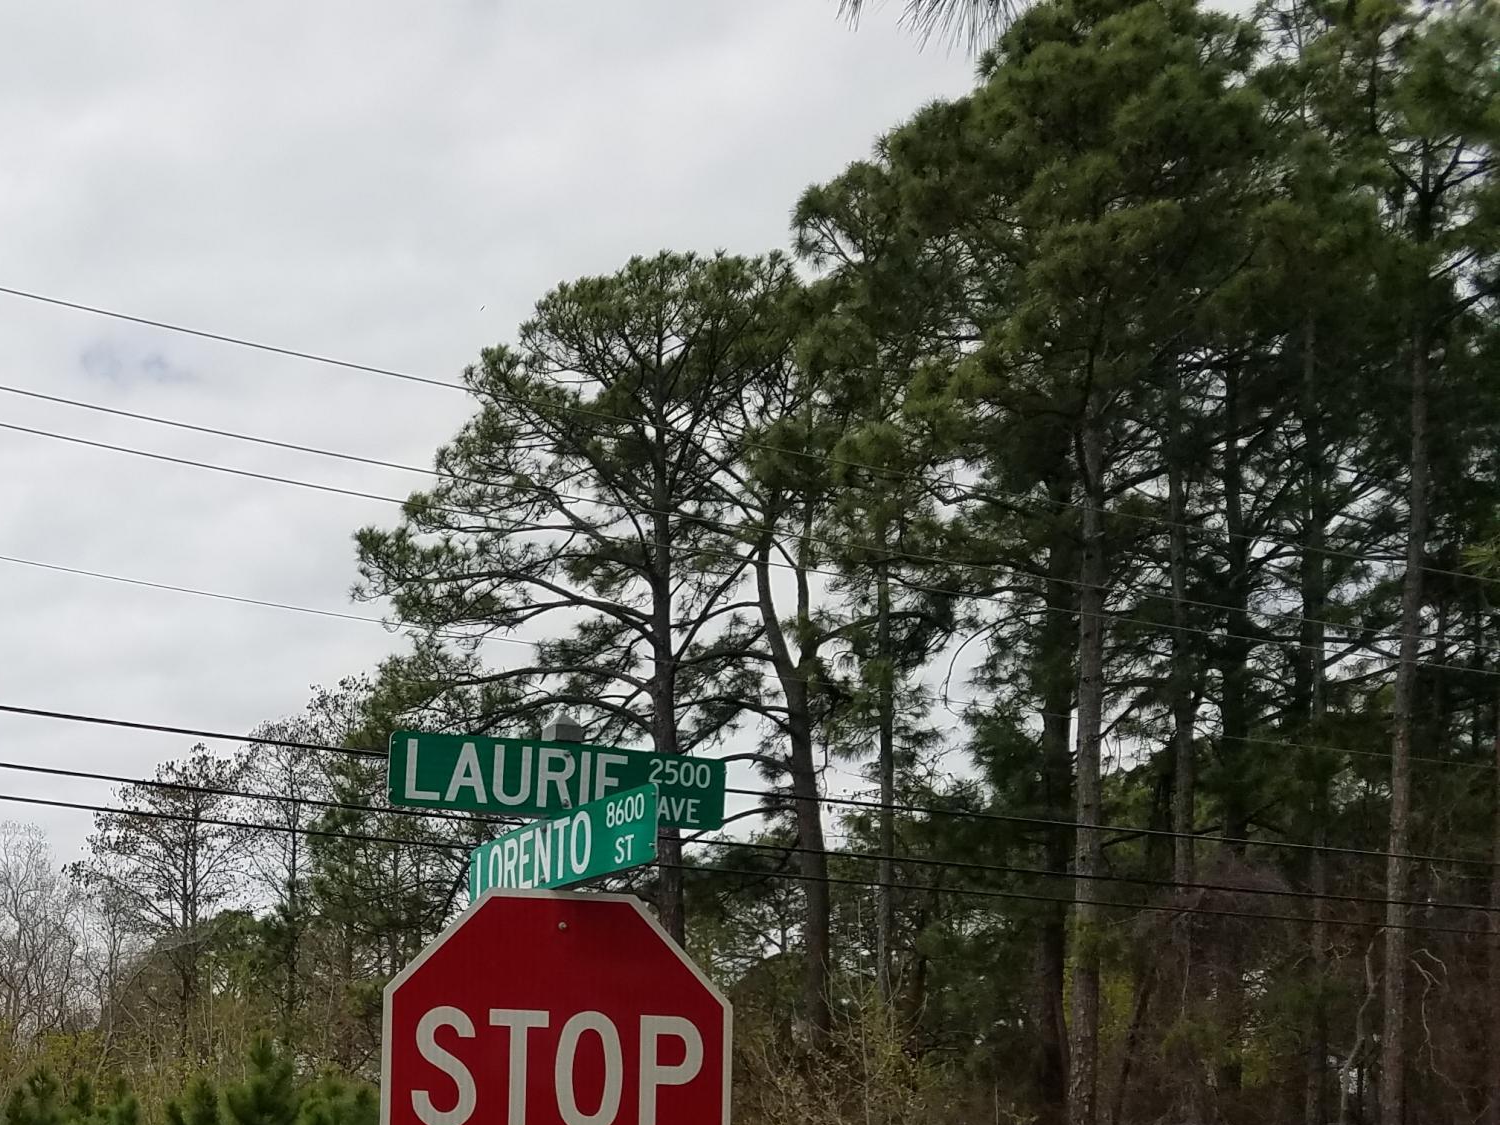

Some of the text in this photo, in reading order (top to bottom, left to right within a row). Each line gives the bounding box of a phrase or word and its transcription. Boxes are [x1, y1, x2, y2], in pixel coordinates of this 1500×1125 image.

[648, 758, 711, 789] 2500
[605, 792, 645, 828] 8600
[657, 795, 701, 824] AVE
[613, 833, 635, 865] ST
